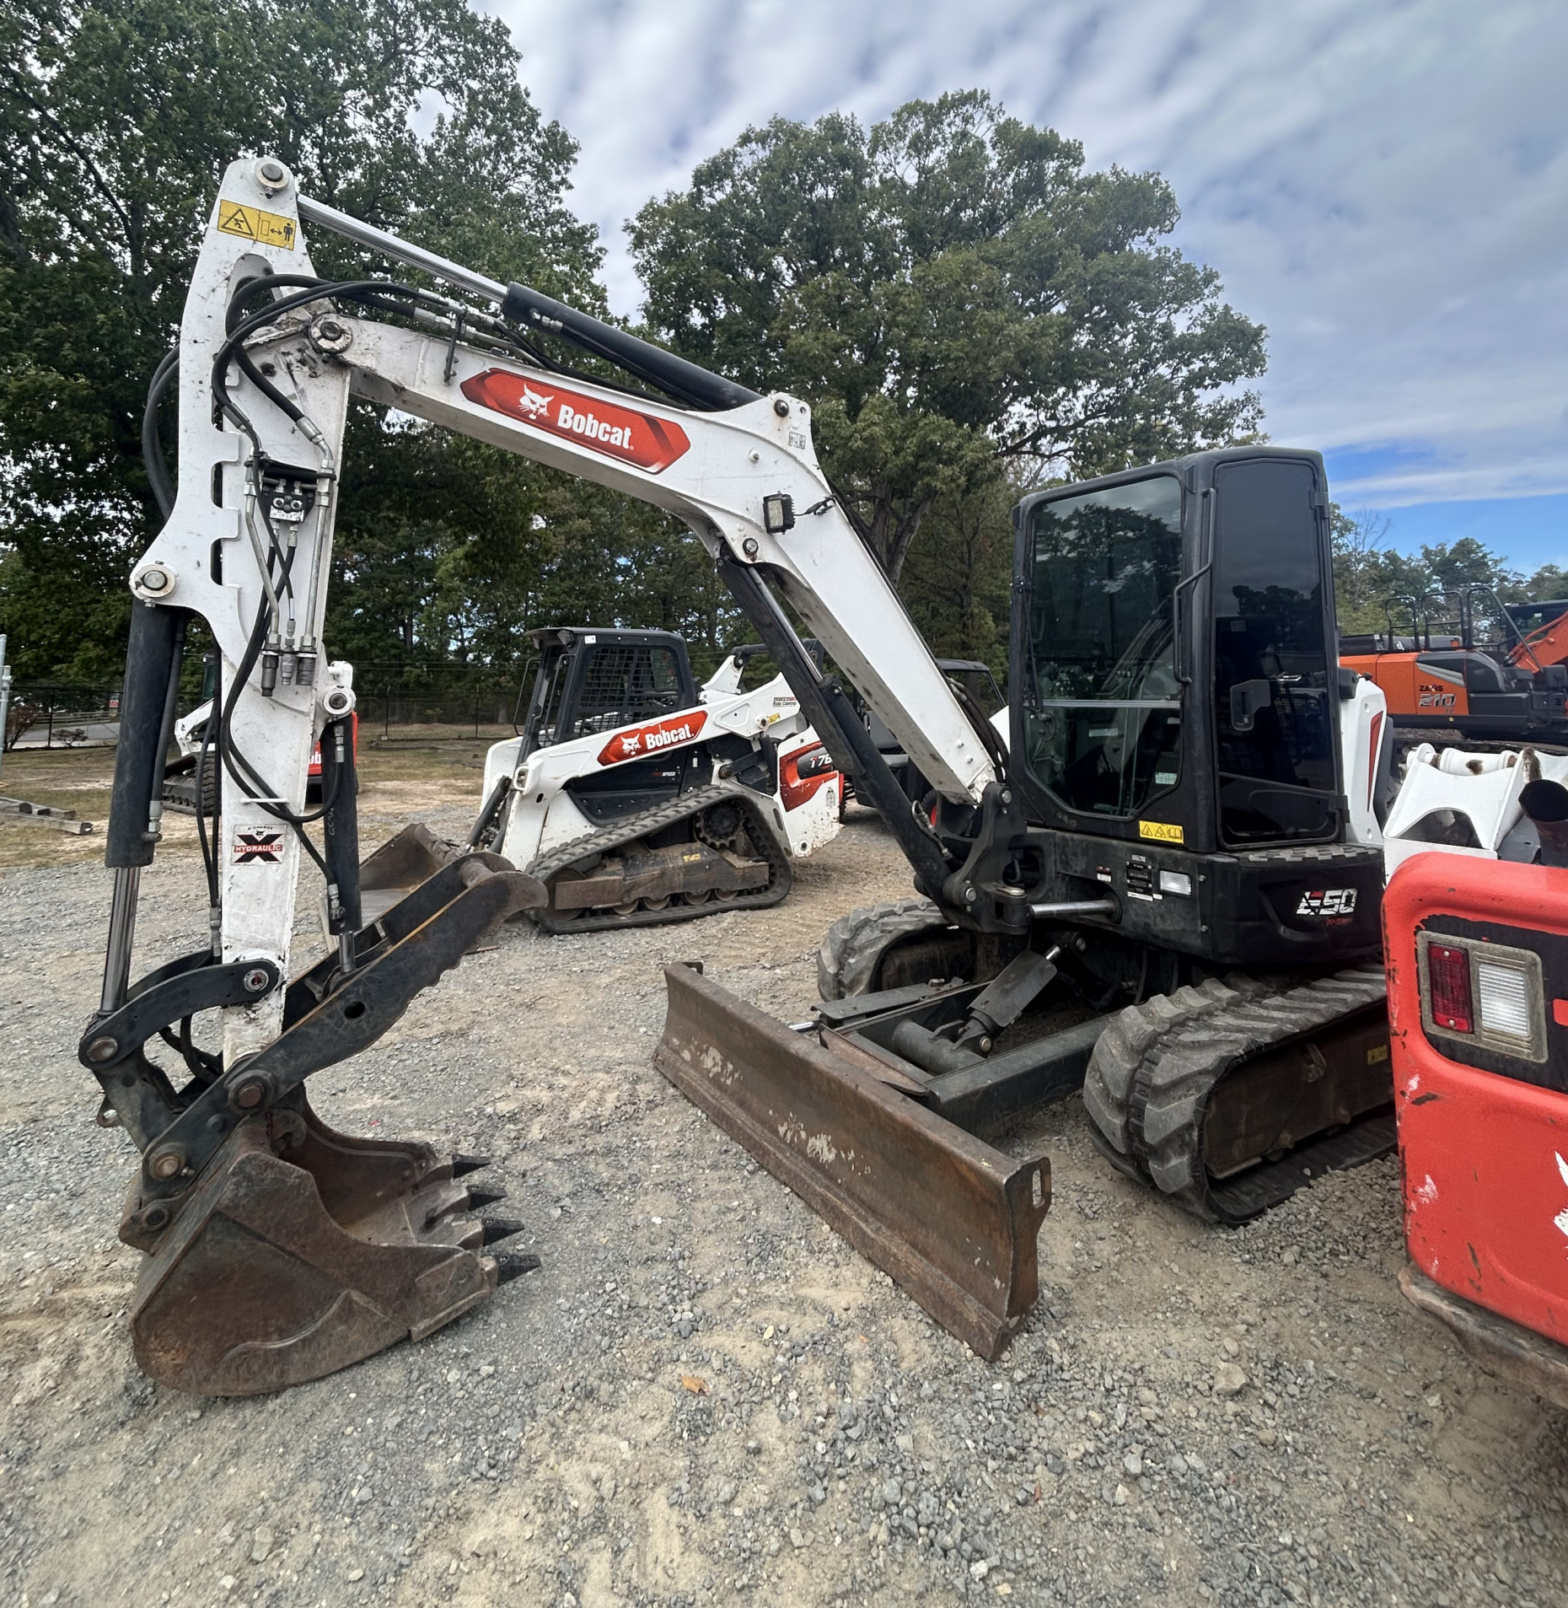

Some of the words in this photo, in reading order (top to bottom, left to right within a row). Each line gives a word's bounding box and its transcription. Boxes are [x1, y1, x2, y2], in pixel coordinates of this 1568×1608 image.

[557, 403, 632, 449] Bobcat
[1418, 693, 1457, 707] 210
[645, 723, 691, 750] Bobcat
[235, 844, 282, 853] HYDRAULIC
